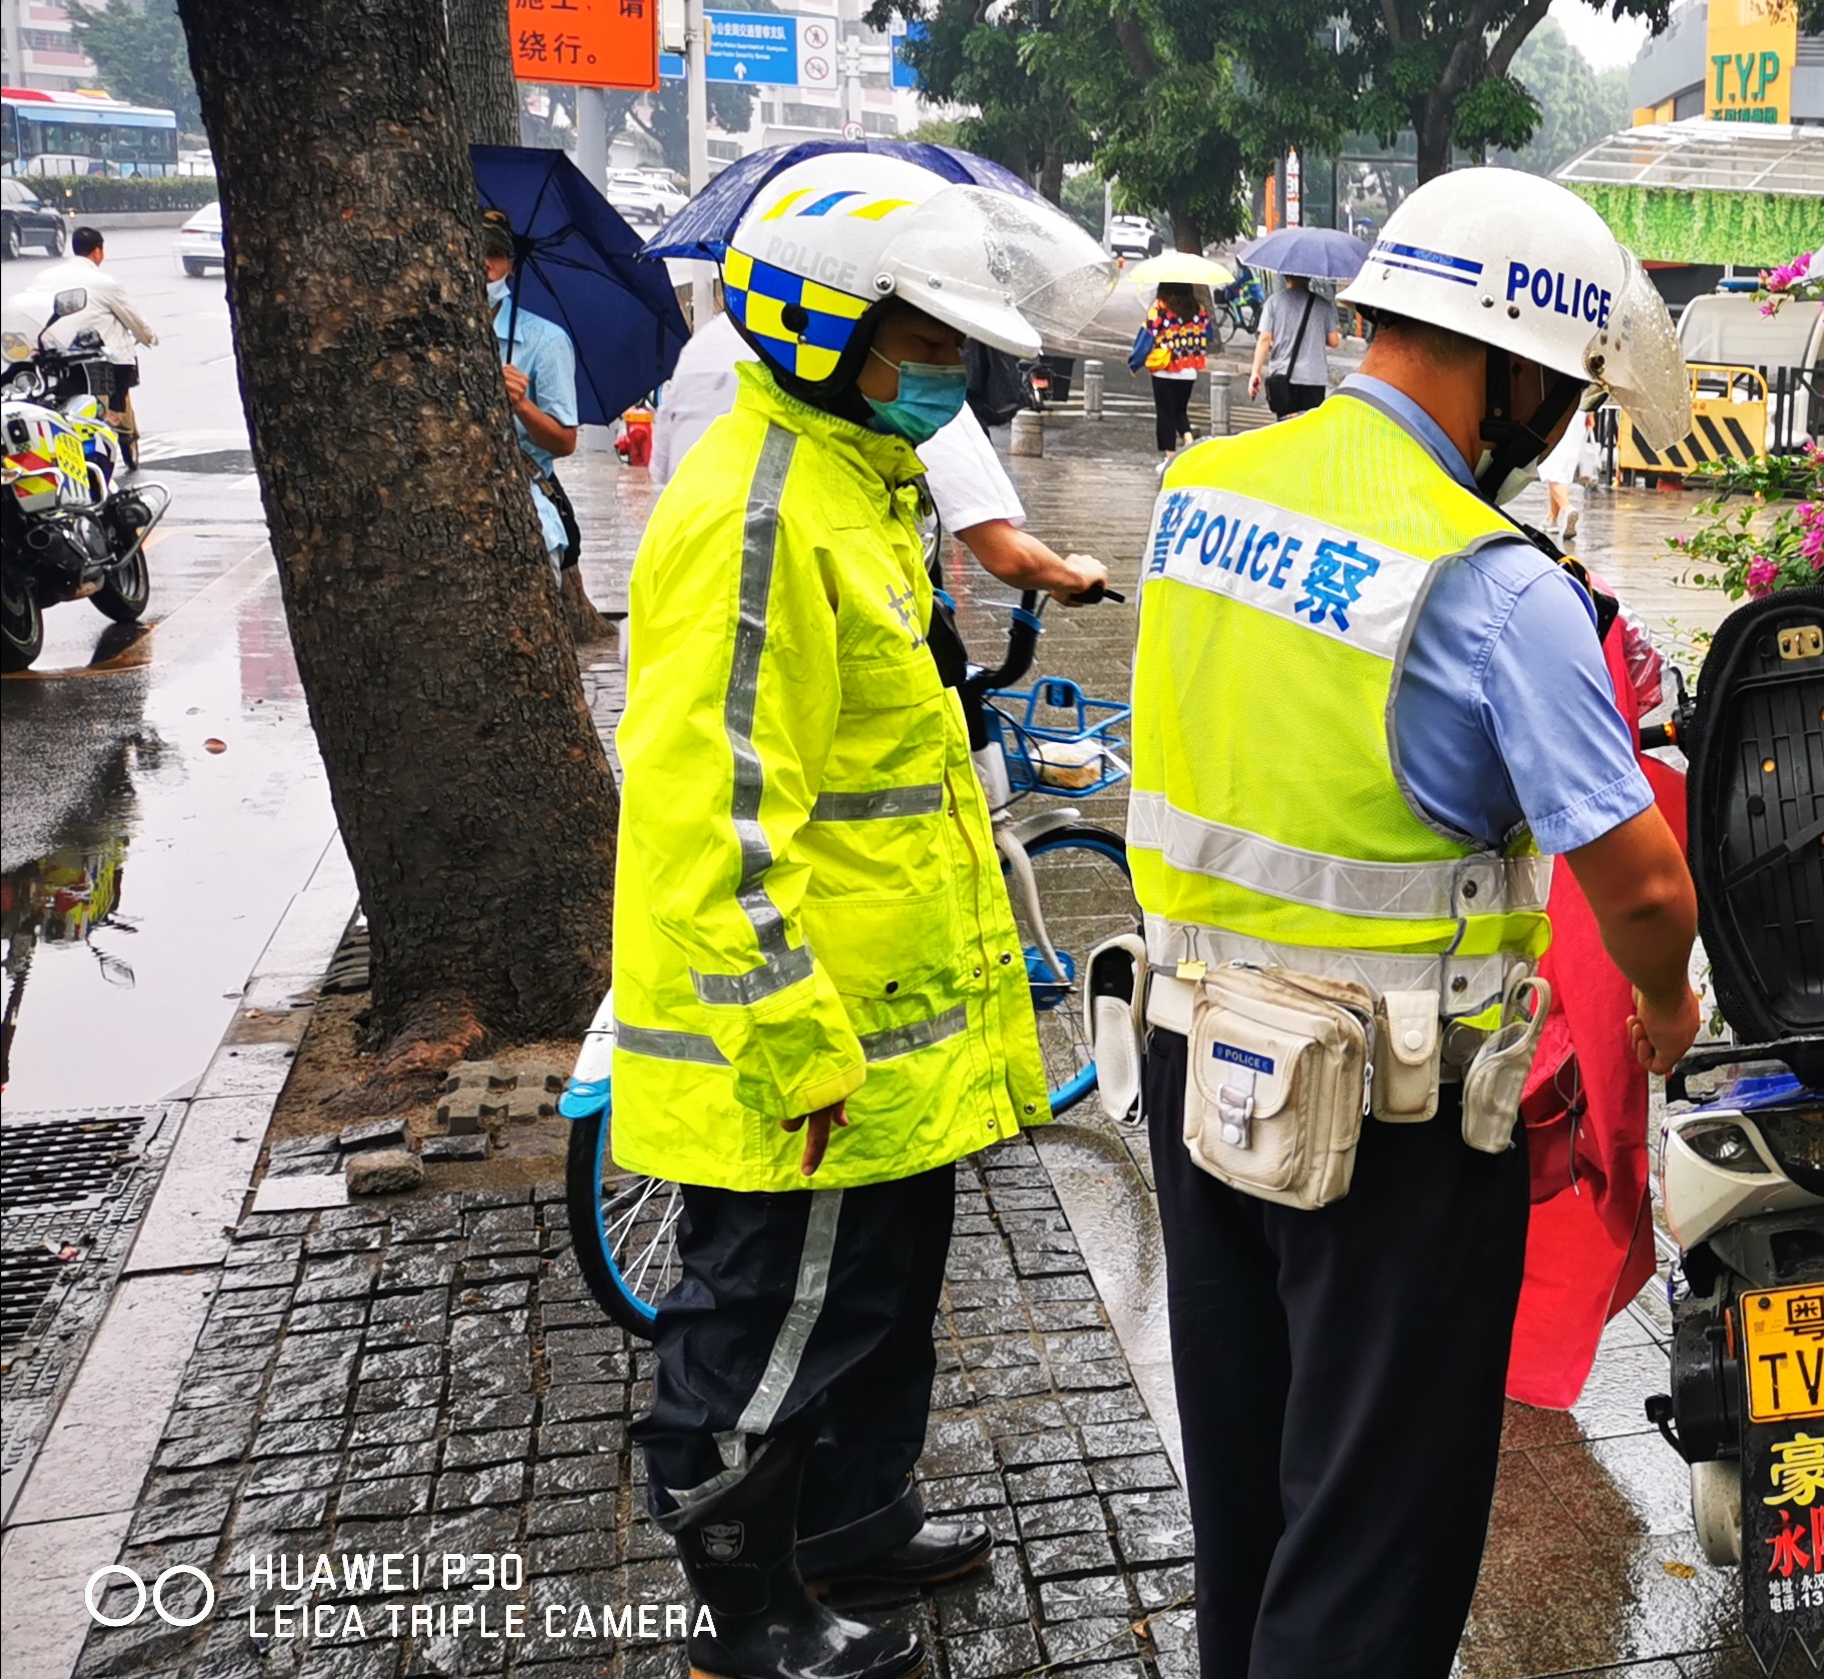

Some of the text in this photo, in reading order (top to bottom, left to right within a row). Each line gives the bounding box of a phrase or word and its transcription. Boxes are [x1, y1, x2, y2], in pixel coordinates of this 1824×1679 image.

[518, 30, 597, 65] 绕行。
[766, 235, 858, 289] POLICE
[1506, 261, 1611, 330] POLICE
[1174, 509, 1303, 590] POLICE
[1294, 538, 1381, 632] 察
[1225, 1048, 1260, 1068] POLICE
